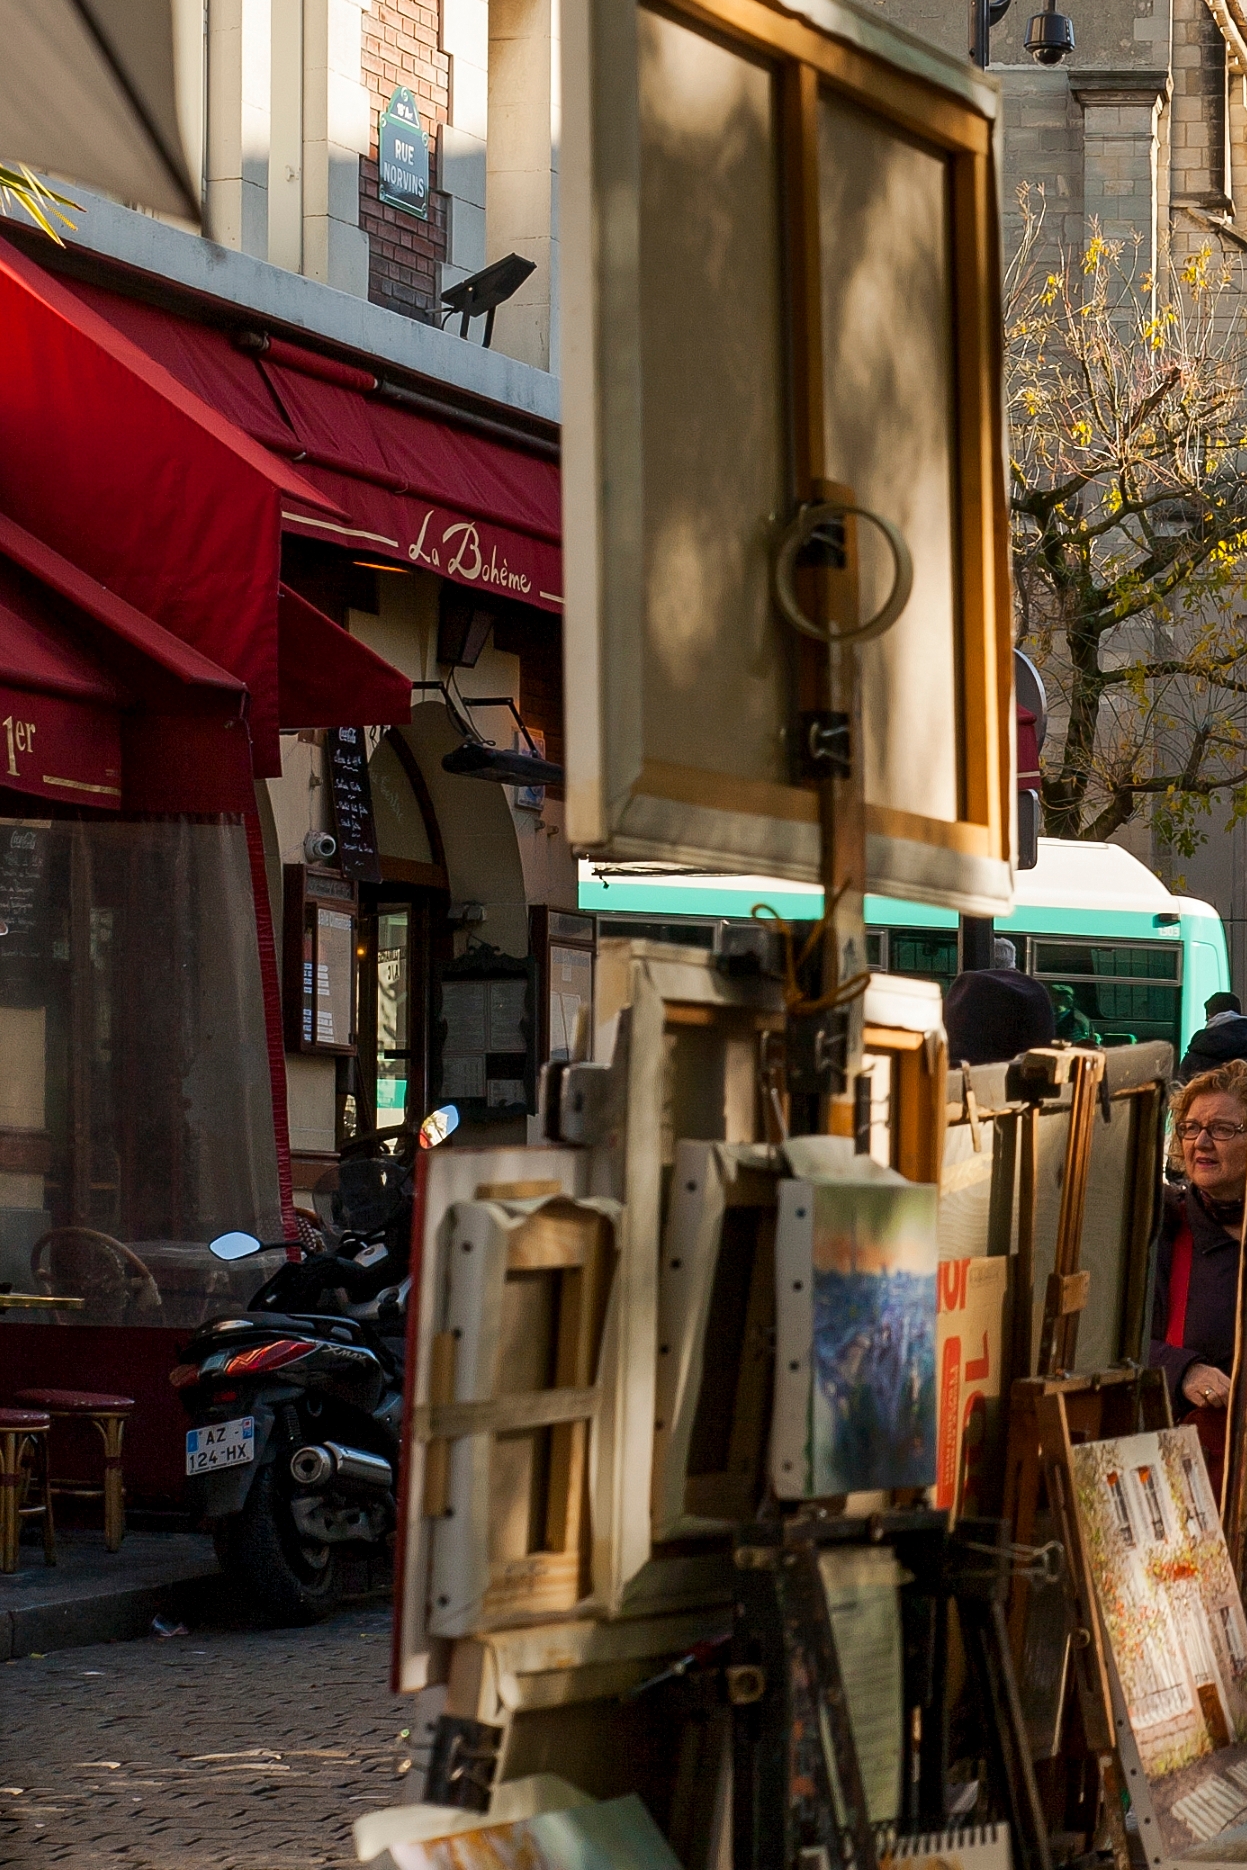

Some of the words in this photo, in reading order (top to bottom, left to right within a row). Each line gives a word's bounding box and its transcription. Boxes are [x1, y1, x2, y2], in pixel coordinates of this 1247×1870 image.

[394, 138, 415, 166] RUE
[383, 162, 425, 198] NORVINS
[408, 509, 440, 567] La
[442, 521, 532, 594] Bohème
[190, 1443, 246, 1469] 124-HX
